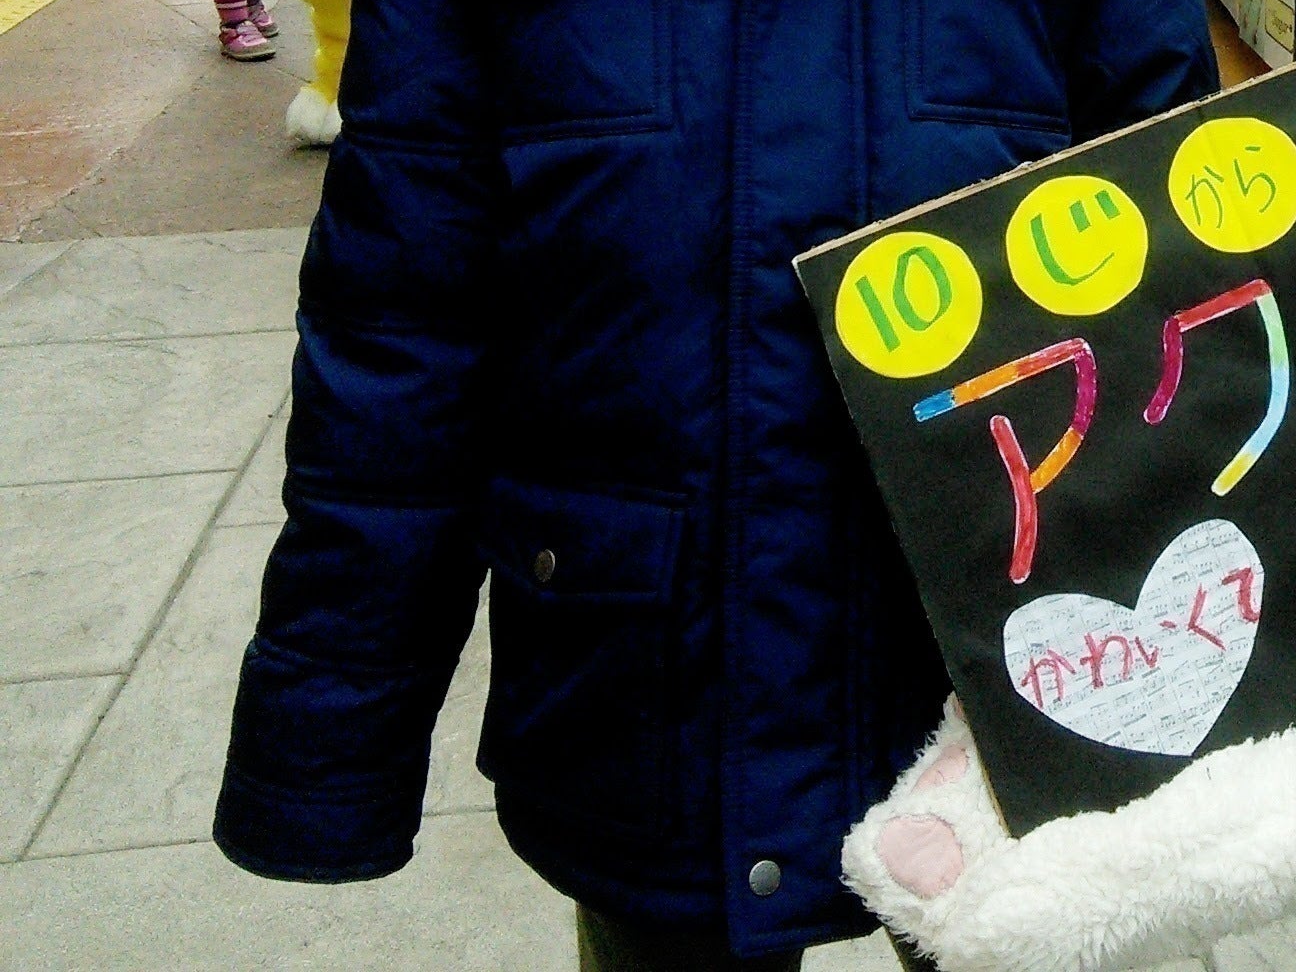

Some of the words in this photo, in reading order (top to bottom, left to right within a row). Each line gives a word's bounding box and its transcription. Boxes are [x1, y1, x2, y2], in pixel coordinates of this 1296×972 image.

[1018, 565, 1262, 710] かわいくて
